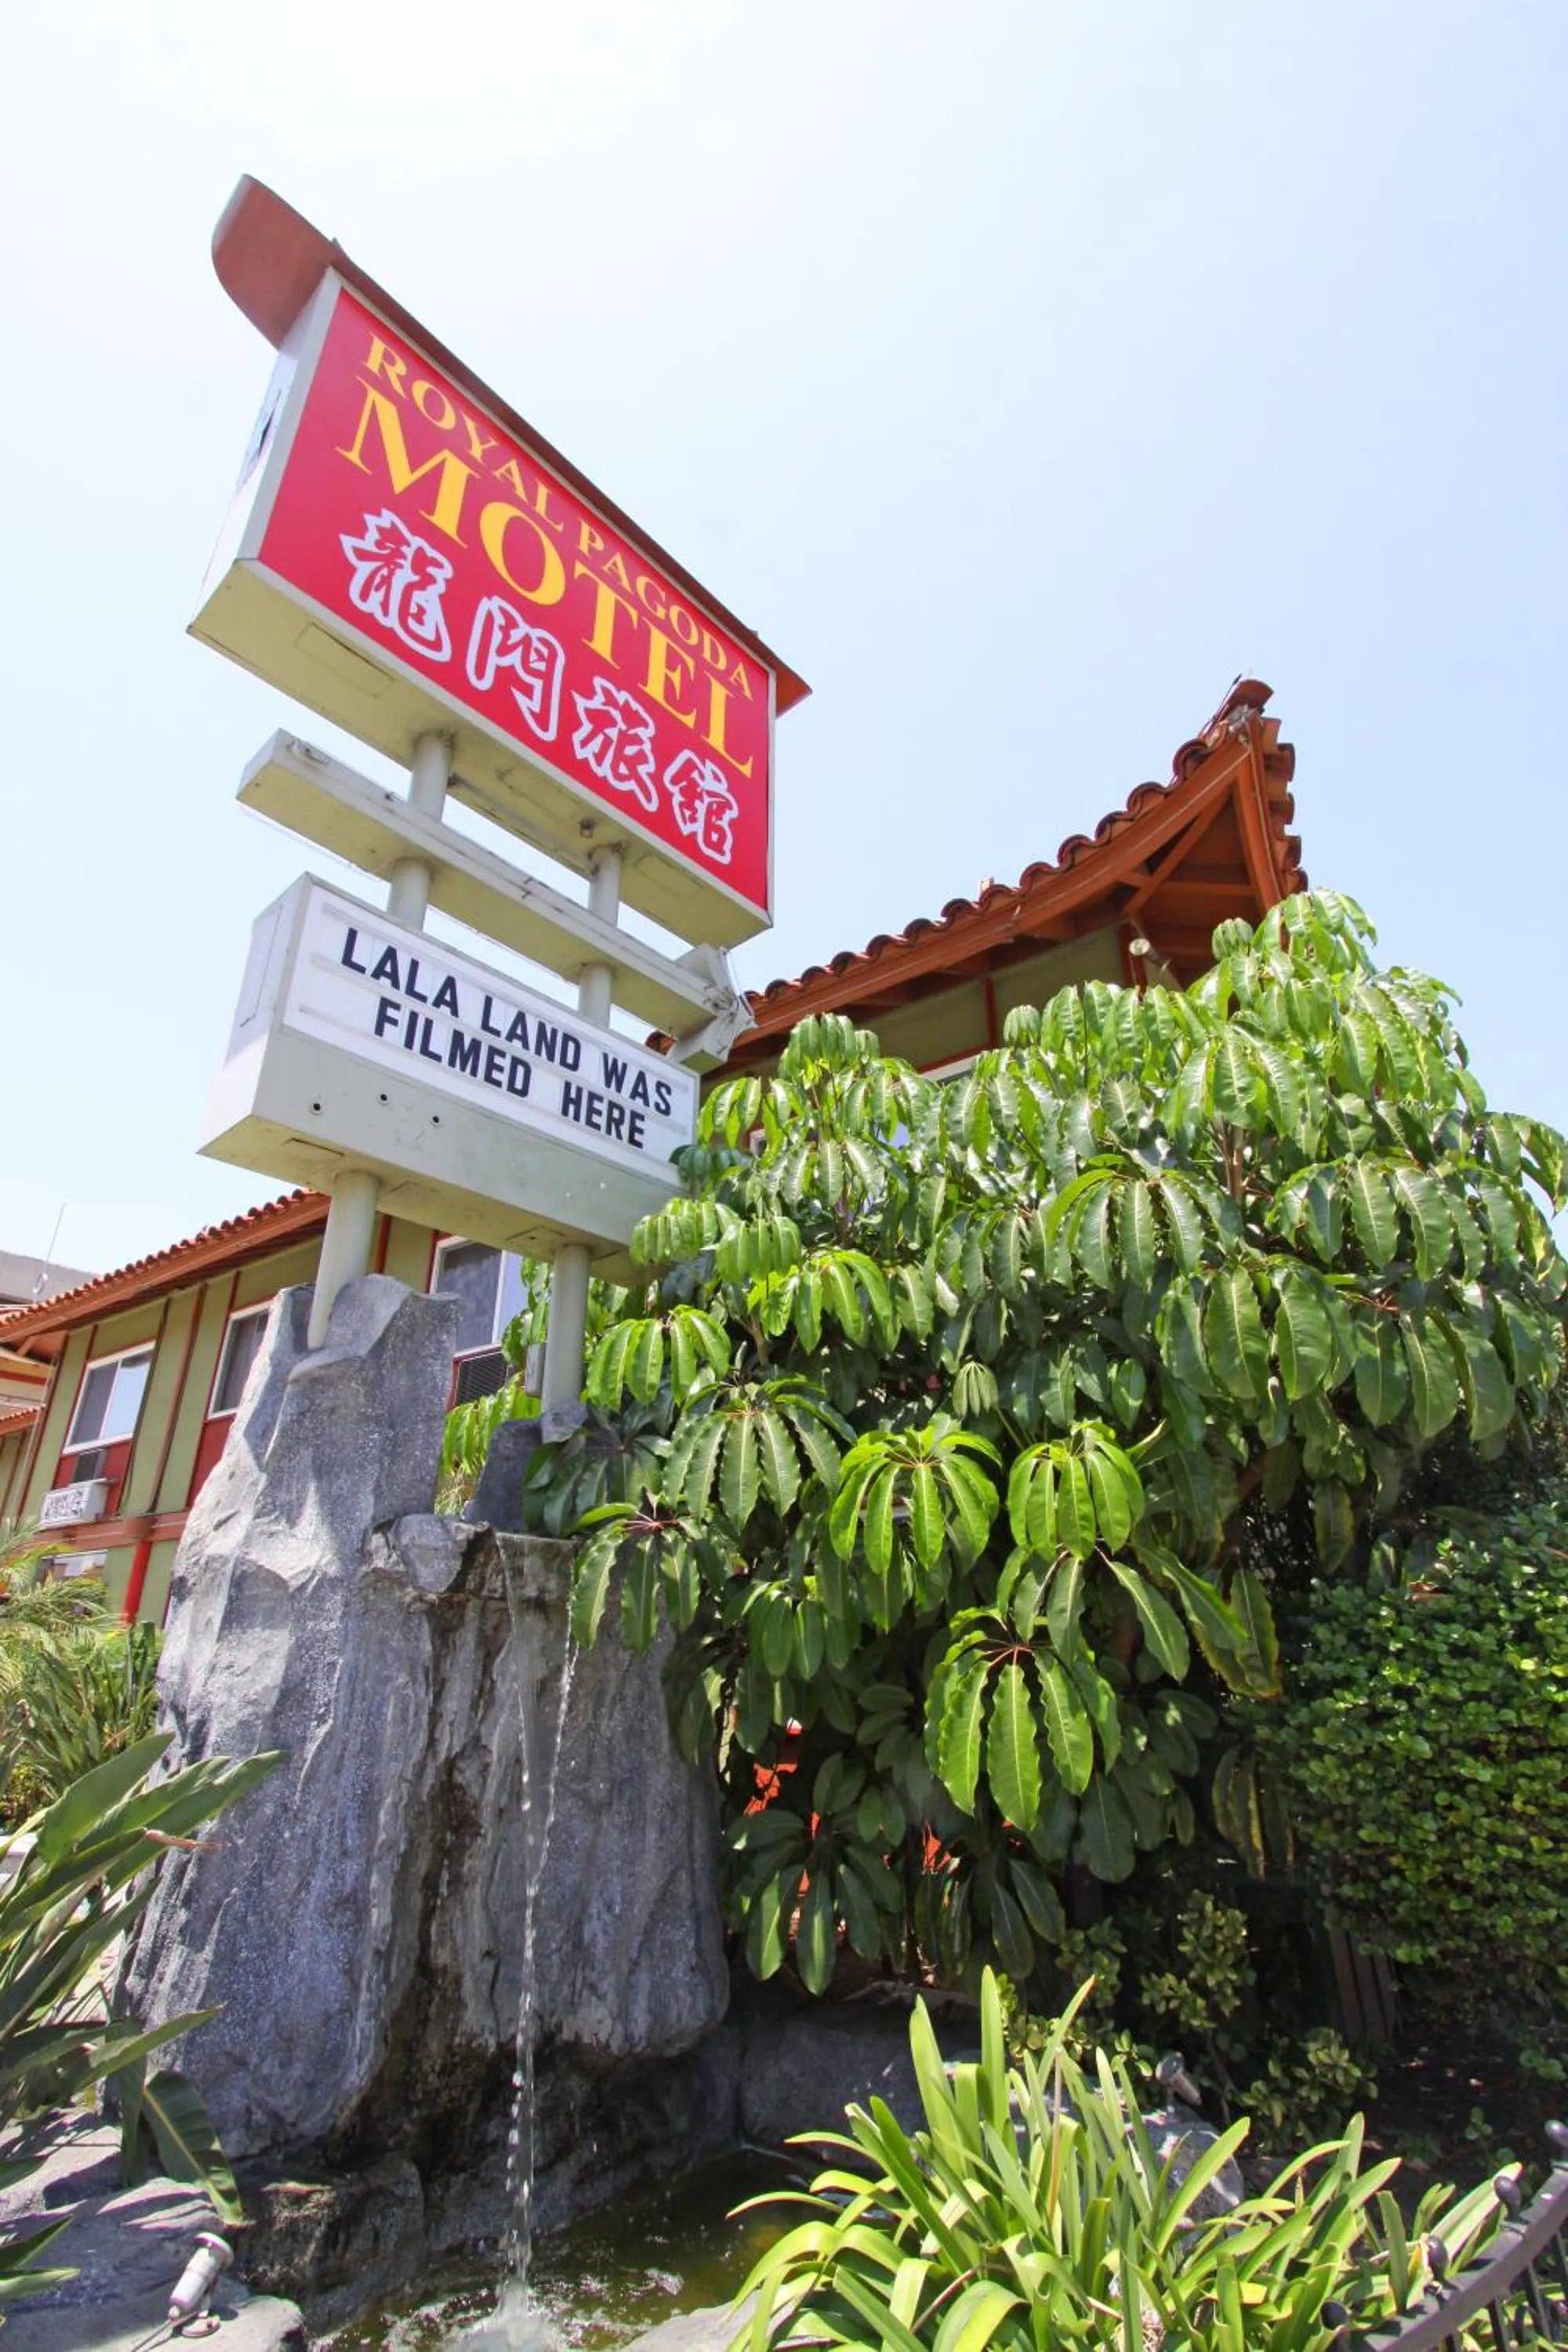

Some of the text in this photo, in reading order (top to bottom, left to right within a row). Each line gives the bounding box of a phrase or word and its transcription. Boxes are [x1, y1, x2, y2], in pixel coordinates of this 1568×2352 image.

[336, 376, 753, 777] MOTEL
[366, 334, 753, 700] ROYAL PAGODA
[341, 927, 672, 1116] LALA LAND WAS
[375, 996, 645, 1149] FILMED HERE
